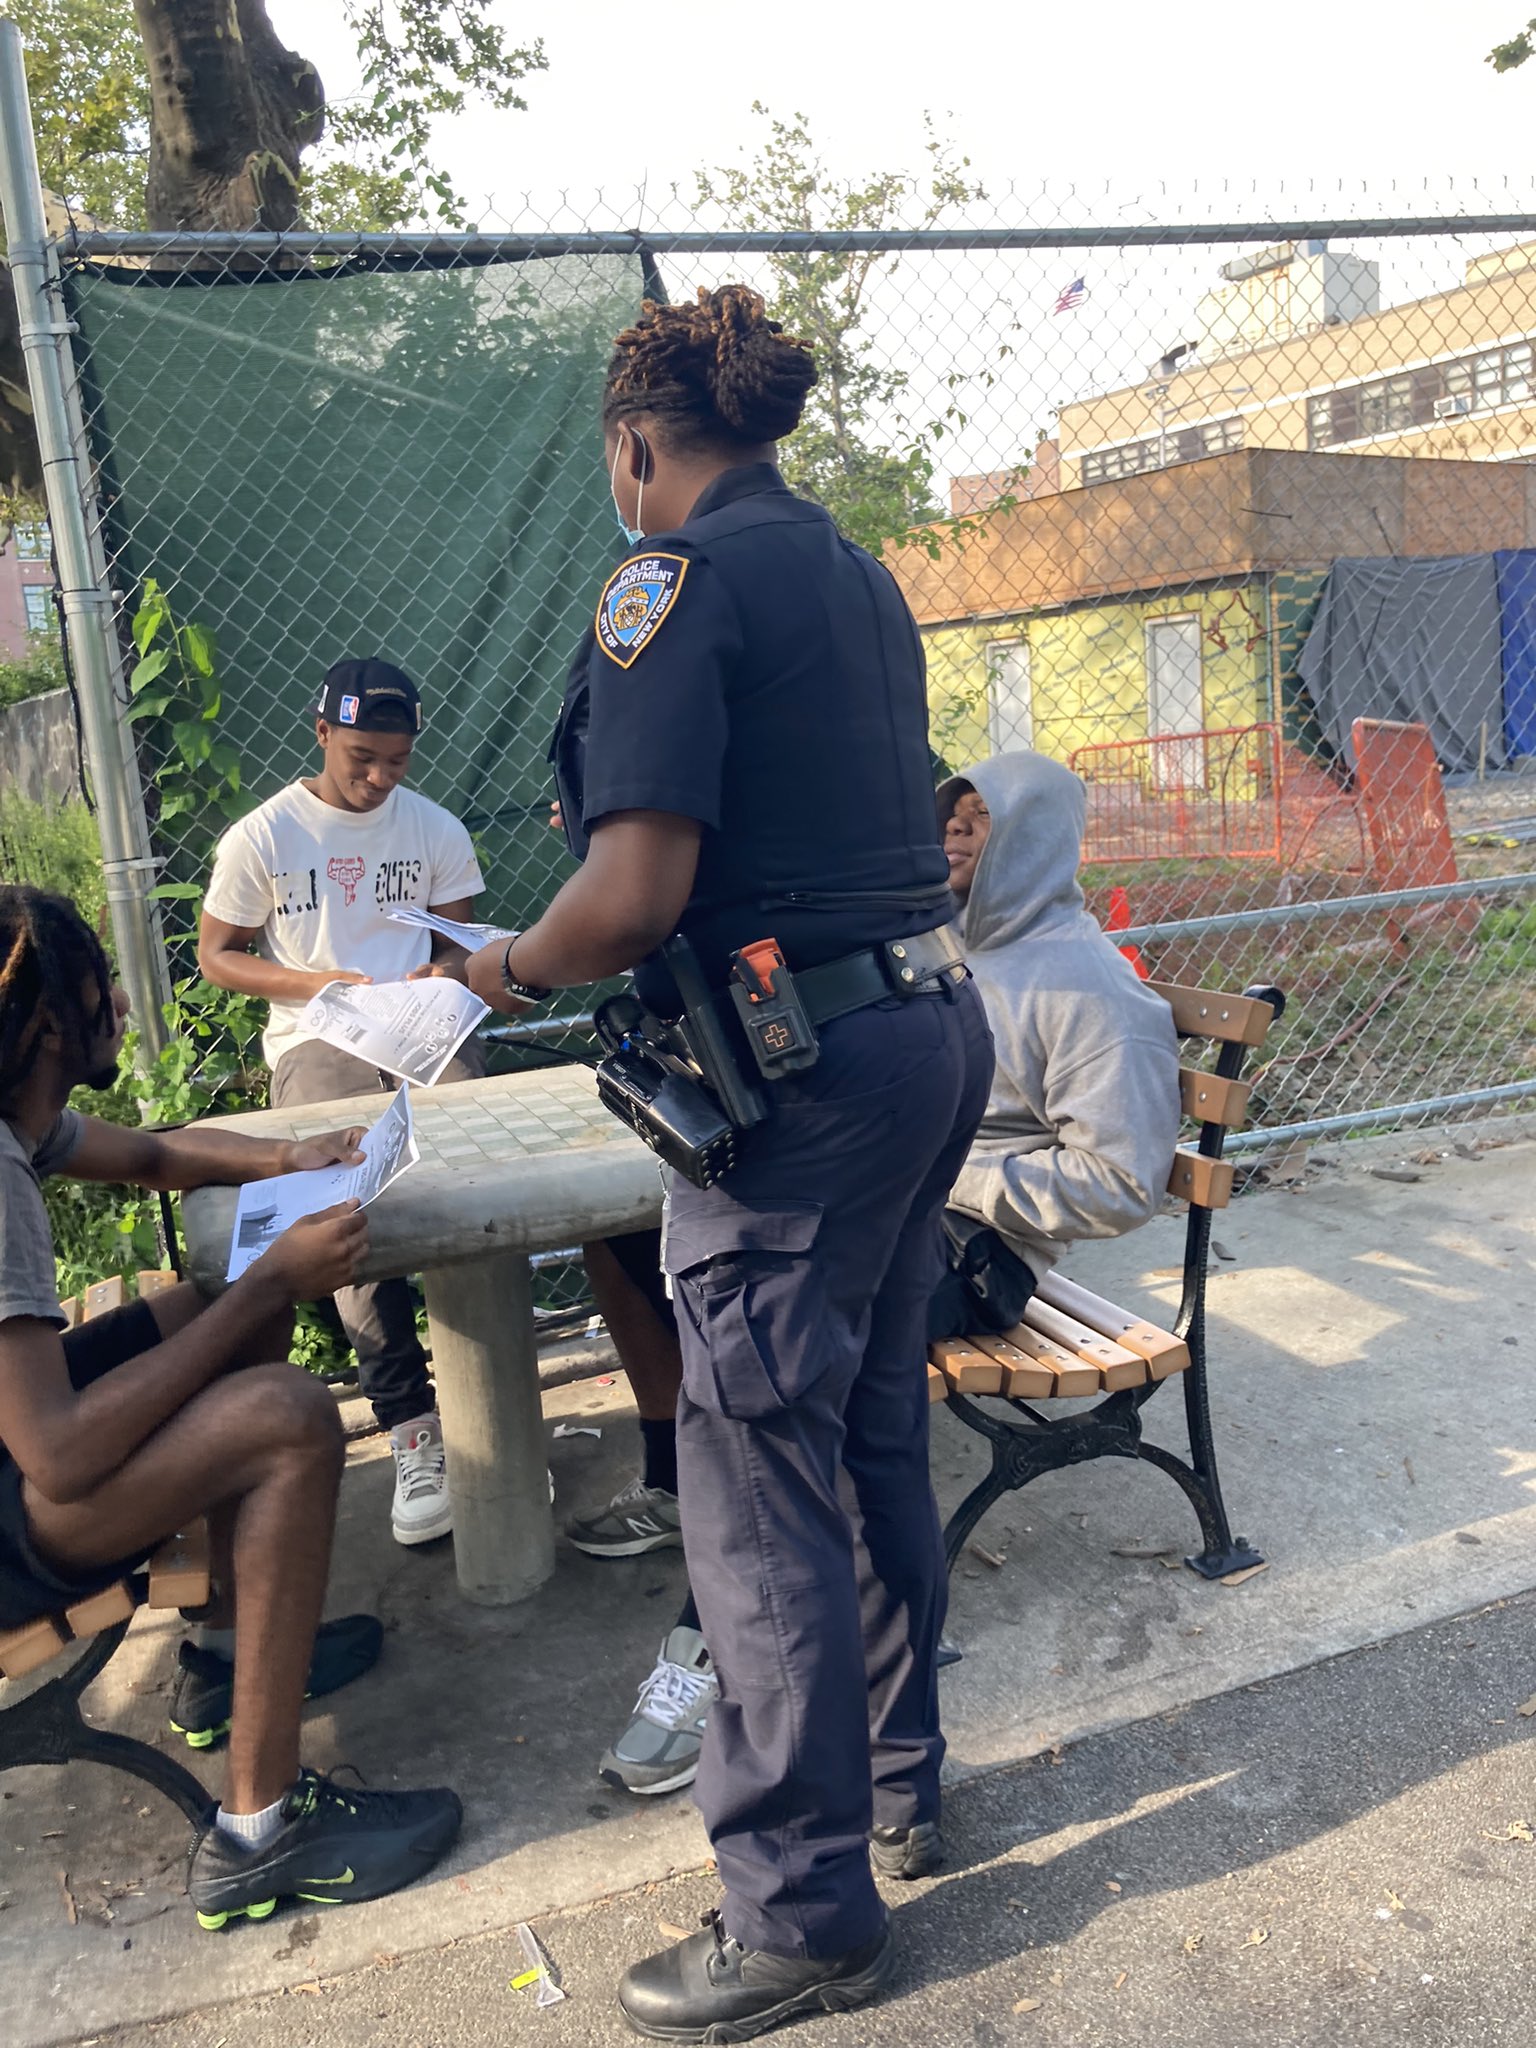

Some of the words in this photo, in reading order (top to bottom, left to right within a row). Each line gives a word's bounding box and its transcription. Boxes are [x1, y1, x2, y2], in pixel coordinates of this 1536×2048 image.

[605, 570, 674, 602] DEPARTMENT
[620, 560, 660, 580] POLICE
[600, 612, 610, 635] CITY
[605, 633, 619, 649] OF
[632, 621, 653, 648] NEW
[650, 588, 674, 621] YORK
